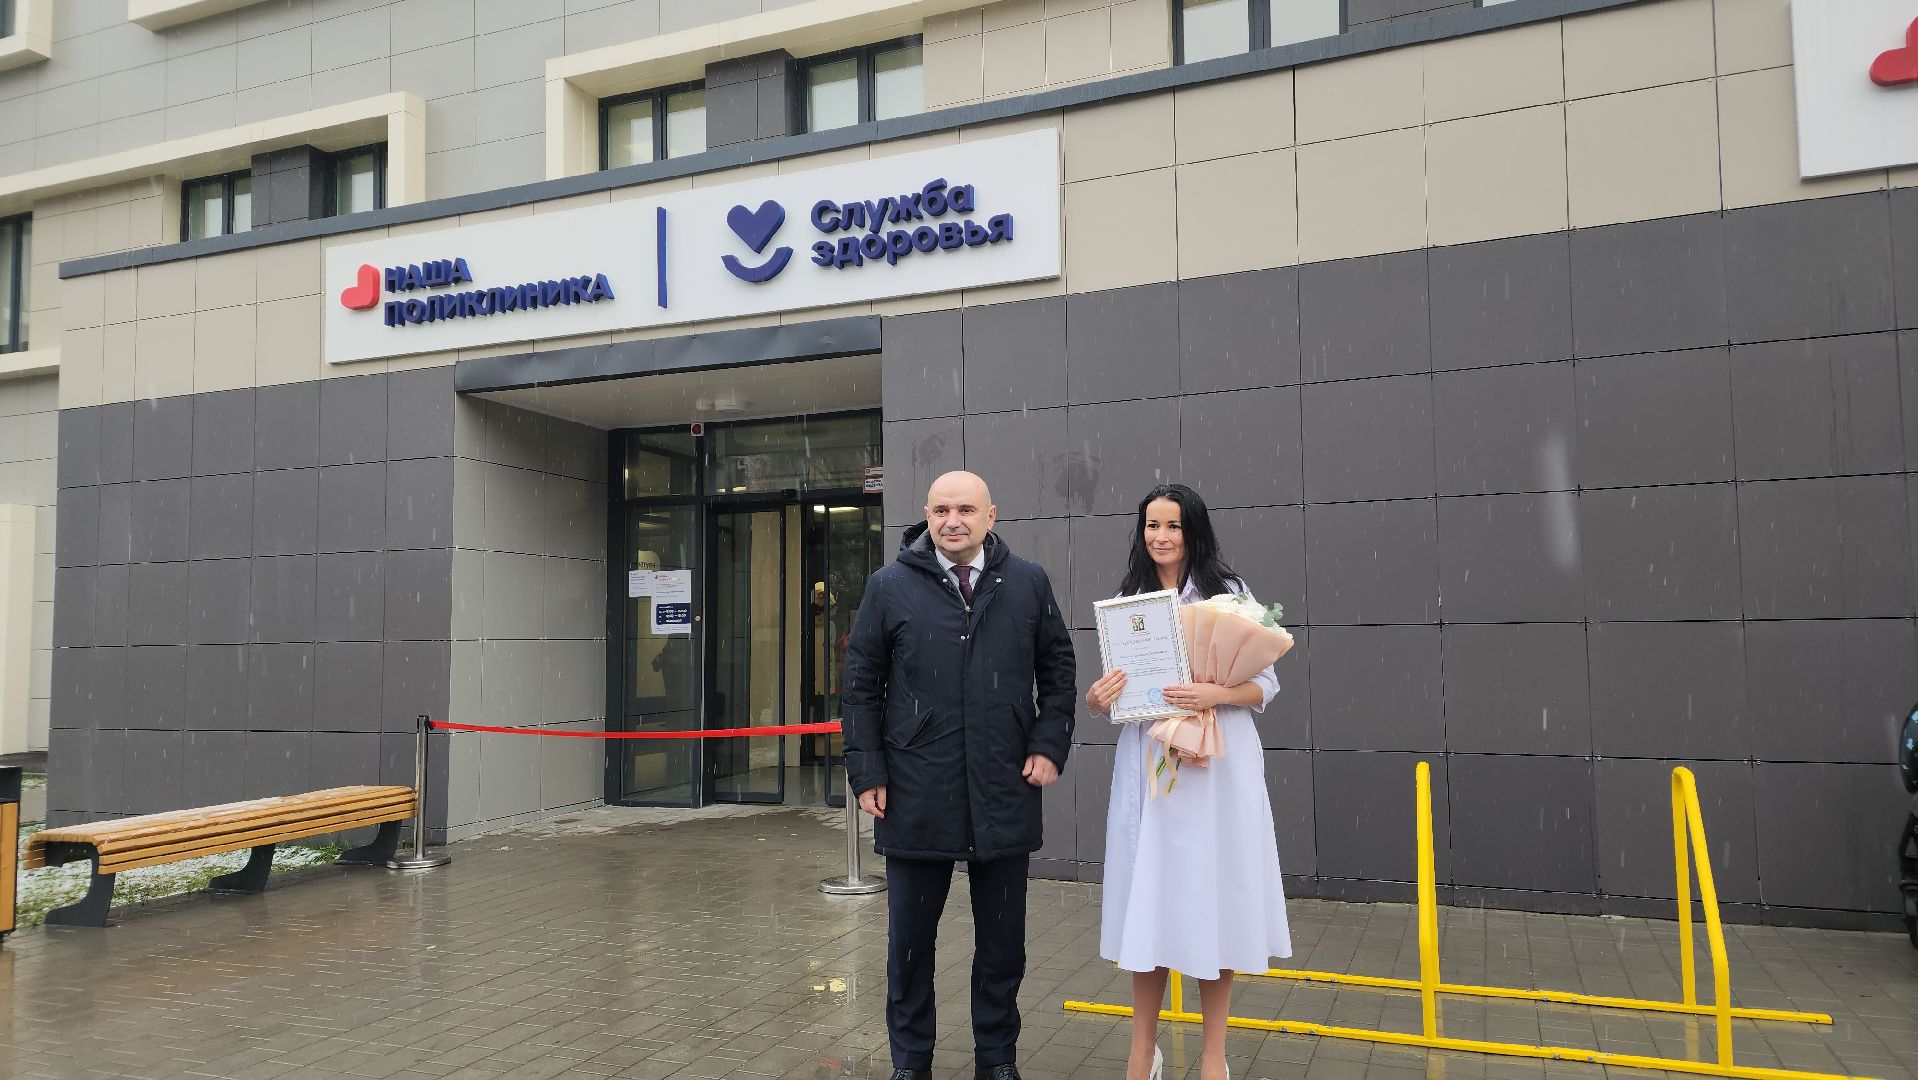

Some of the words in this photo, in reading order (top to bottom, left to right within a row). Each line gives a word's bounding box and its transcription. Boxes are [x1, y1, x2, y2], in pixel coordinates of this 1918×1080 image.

[811, 177, 975, 234] Служба
[811, 213, 1014, 269] здоровья
[384, 257, 473, 293] НАША
[384, 272, 615, 328] ПОЛИКЛИНИКА
